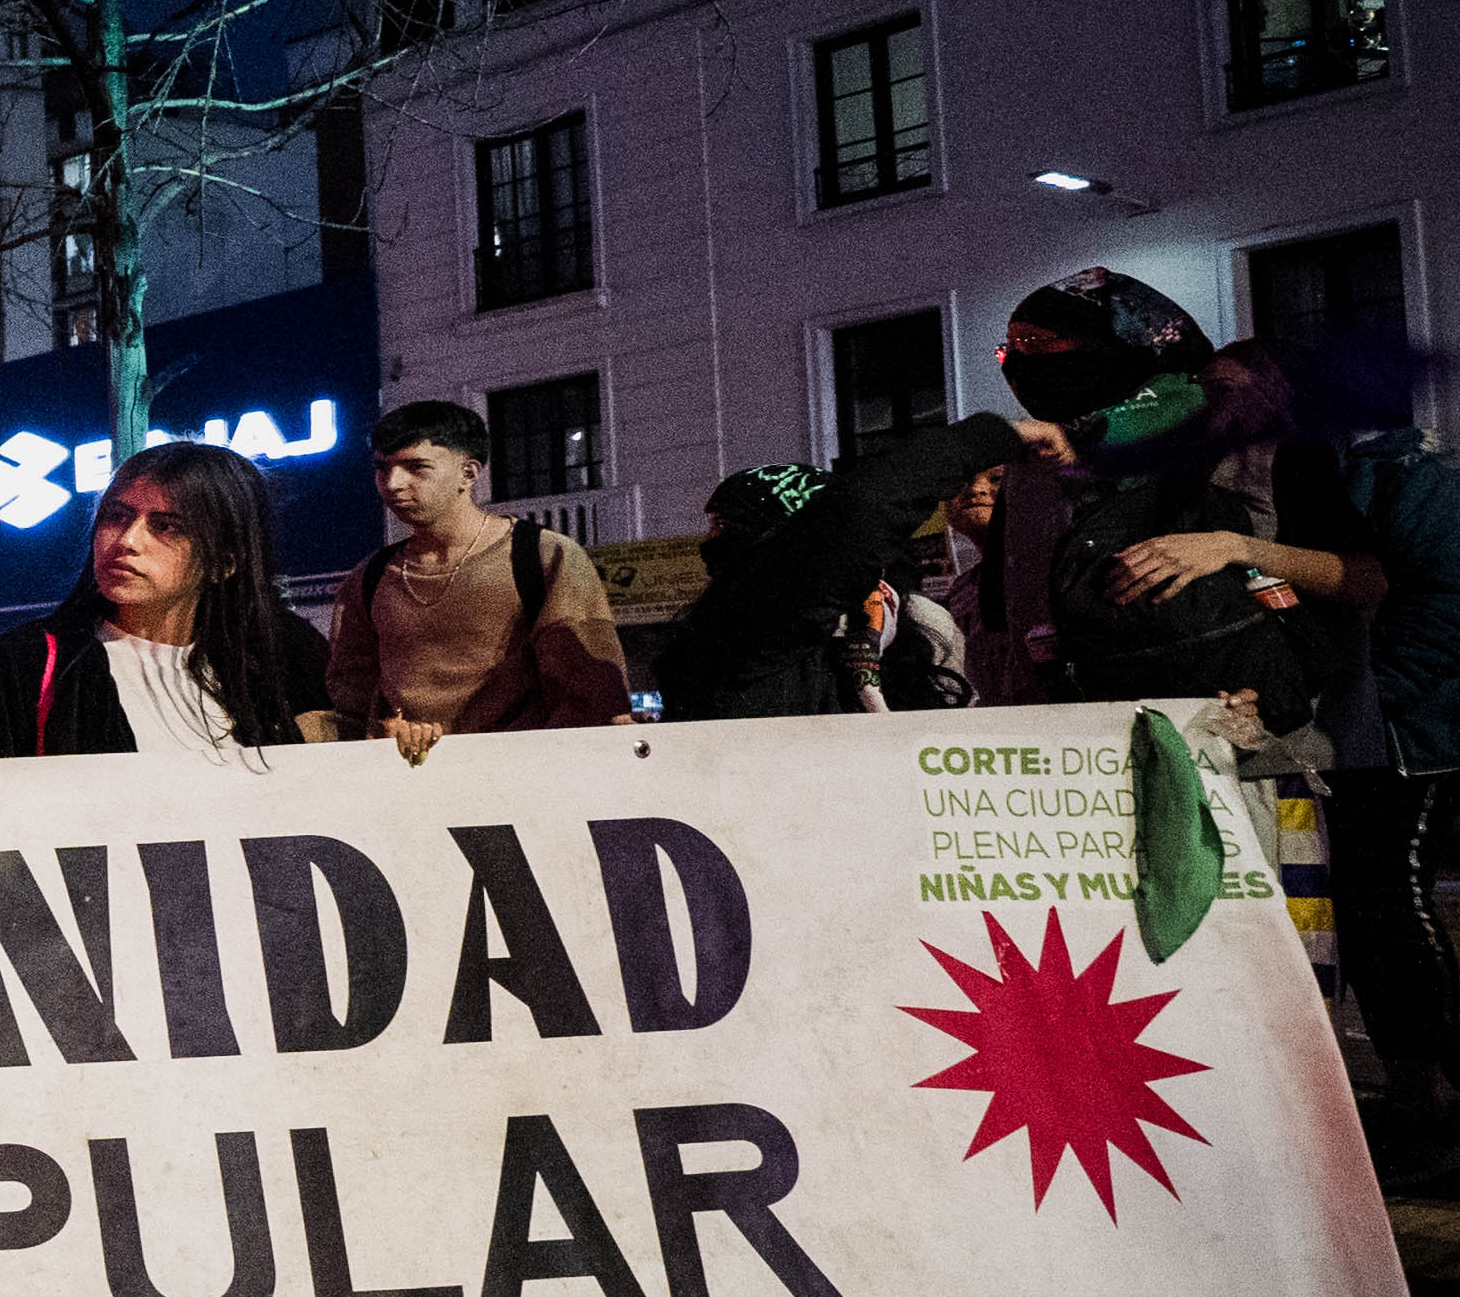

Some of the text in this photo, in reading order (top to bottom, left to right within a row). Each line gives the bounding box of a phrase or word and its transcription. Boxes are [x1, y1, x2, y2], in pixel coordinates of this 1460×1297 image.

[74, 399, 337, 493] BAJ
[918, 746, 1051, 776] CORTE:
[923, 788, 1234, 817] UNA CIUDADA
[933, 830, 1136, 860] PLENA PAR
[920, 864, 1274, 902] NIÑAS Y MUES
